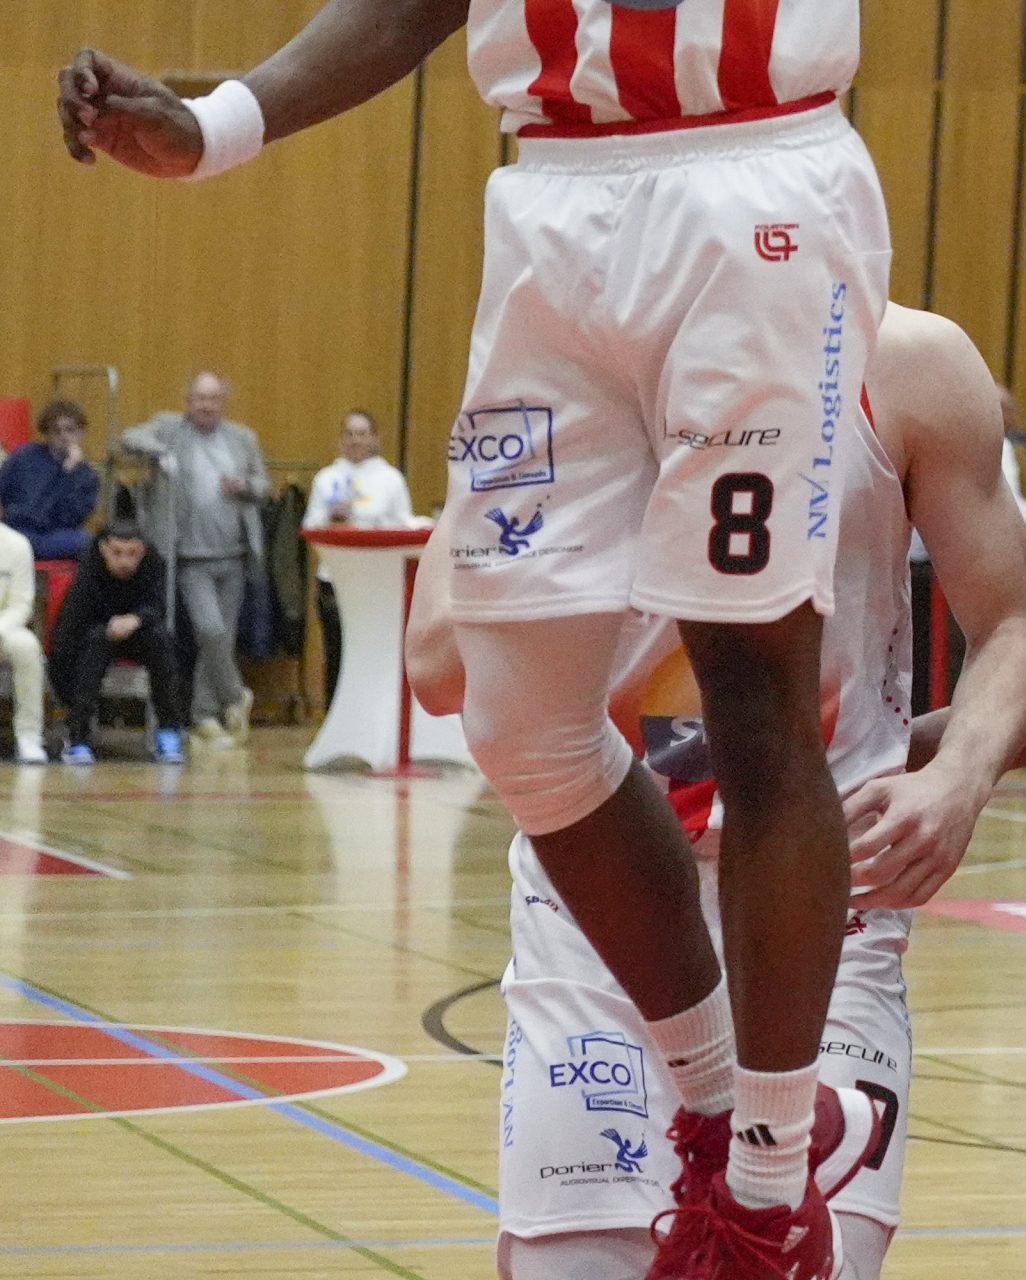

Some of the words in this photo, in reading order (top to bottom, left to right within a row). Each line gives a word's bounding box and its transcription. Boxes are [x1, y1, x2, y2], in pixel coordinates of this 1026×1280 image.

[811, 281, 847, 469] Logistics
[708, 471, 775, 576] 8
[549, 1060, 632, 1088] EXCO
[540, 1161, 613, 1180] Dorier
